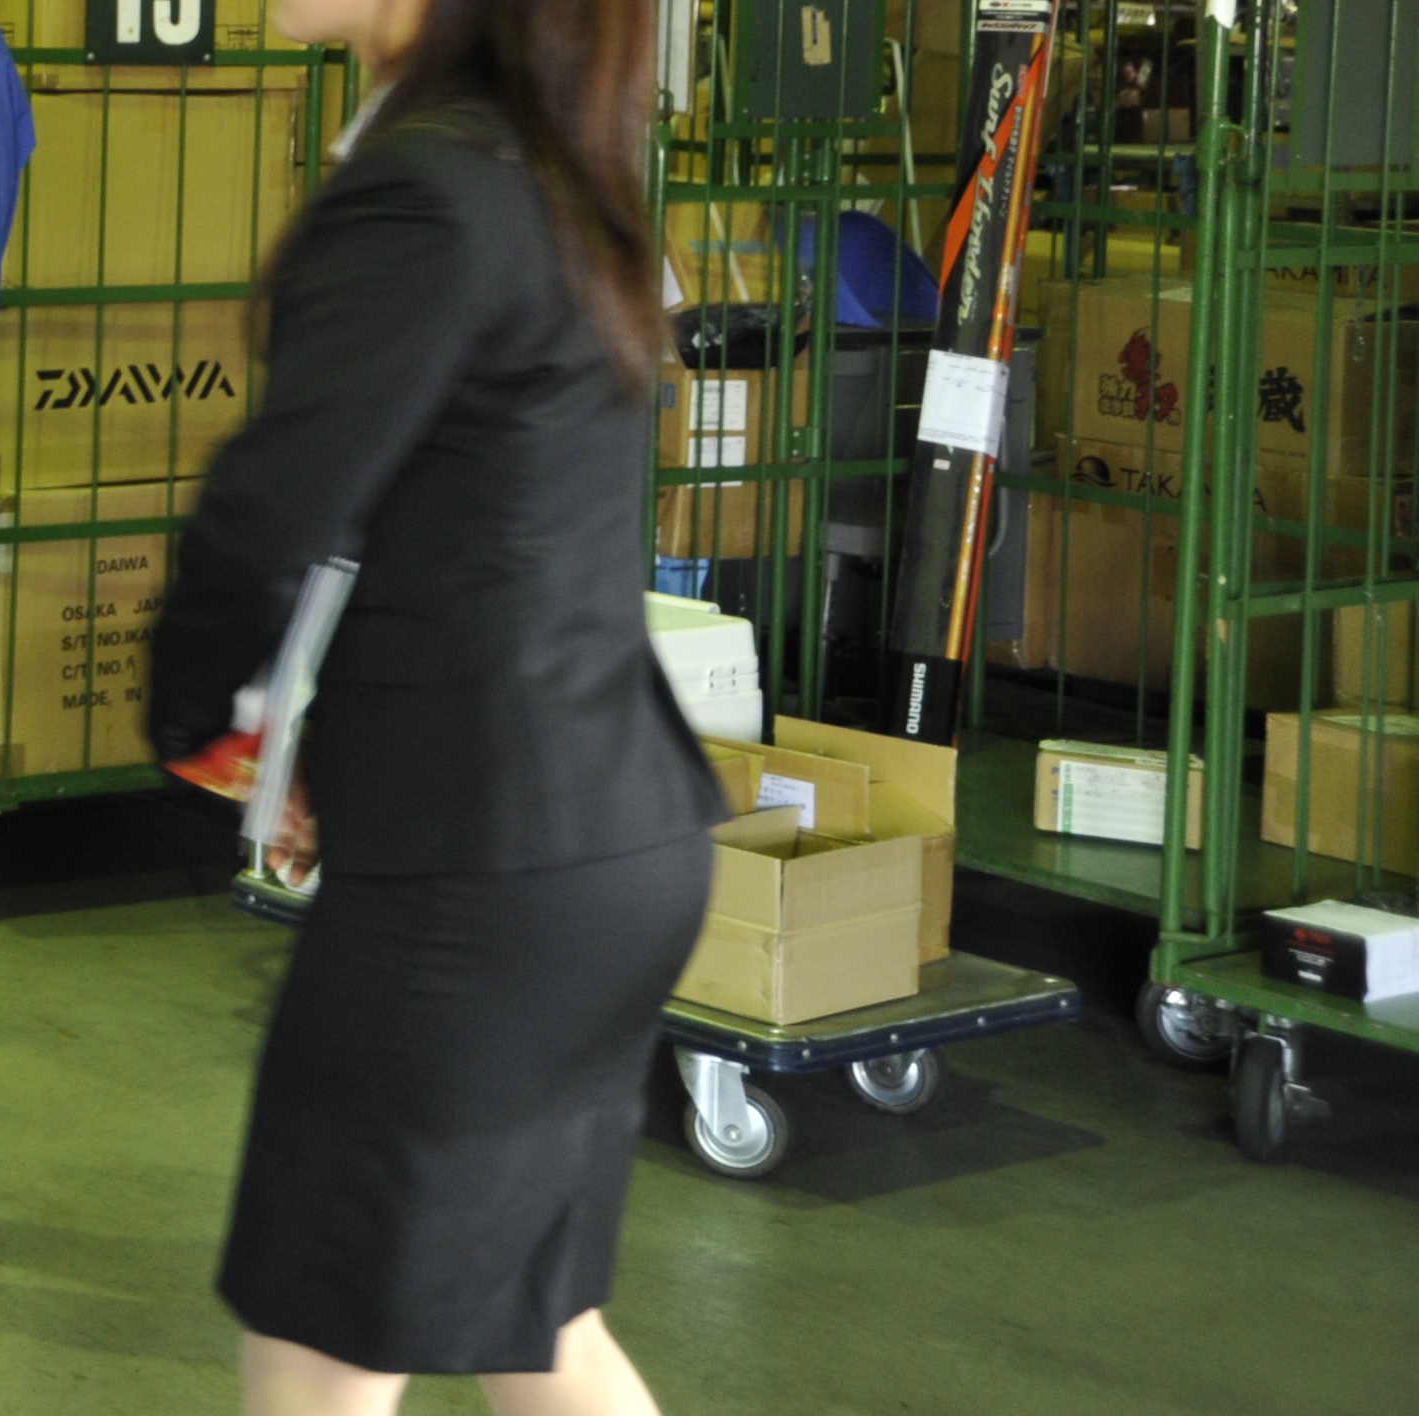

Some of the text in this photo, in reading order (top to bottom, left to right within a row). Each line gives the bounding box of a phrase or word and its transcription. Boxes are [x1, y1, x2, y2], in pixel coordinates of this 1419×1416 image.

[35, 360, 236, 411] DAIWA
[97, 555, 149, 575] DAIWA
[126, 686, 143, 703] IN
[906, 662, 927, 735] SHIMANO
